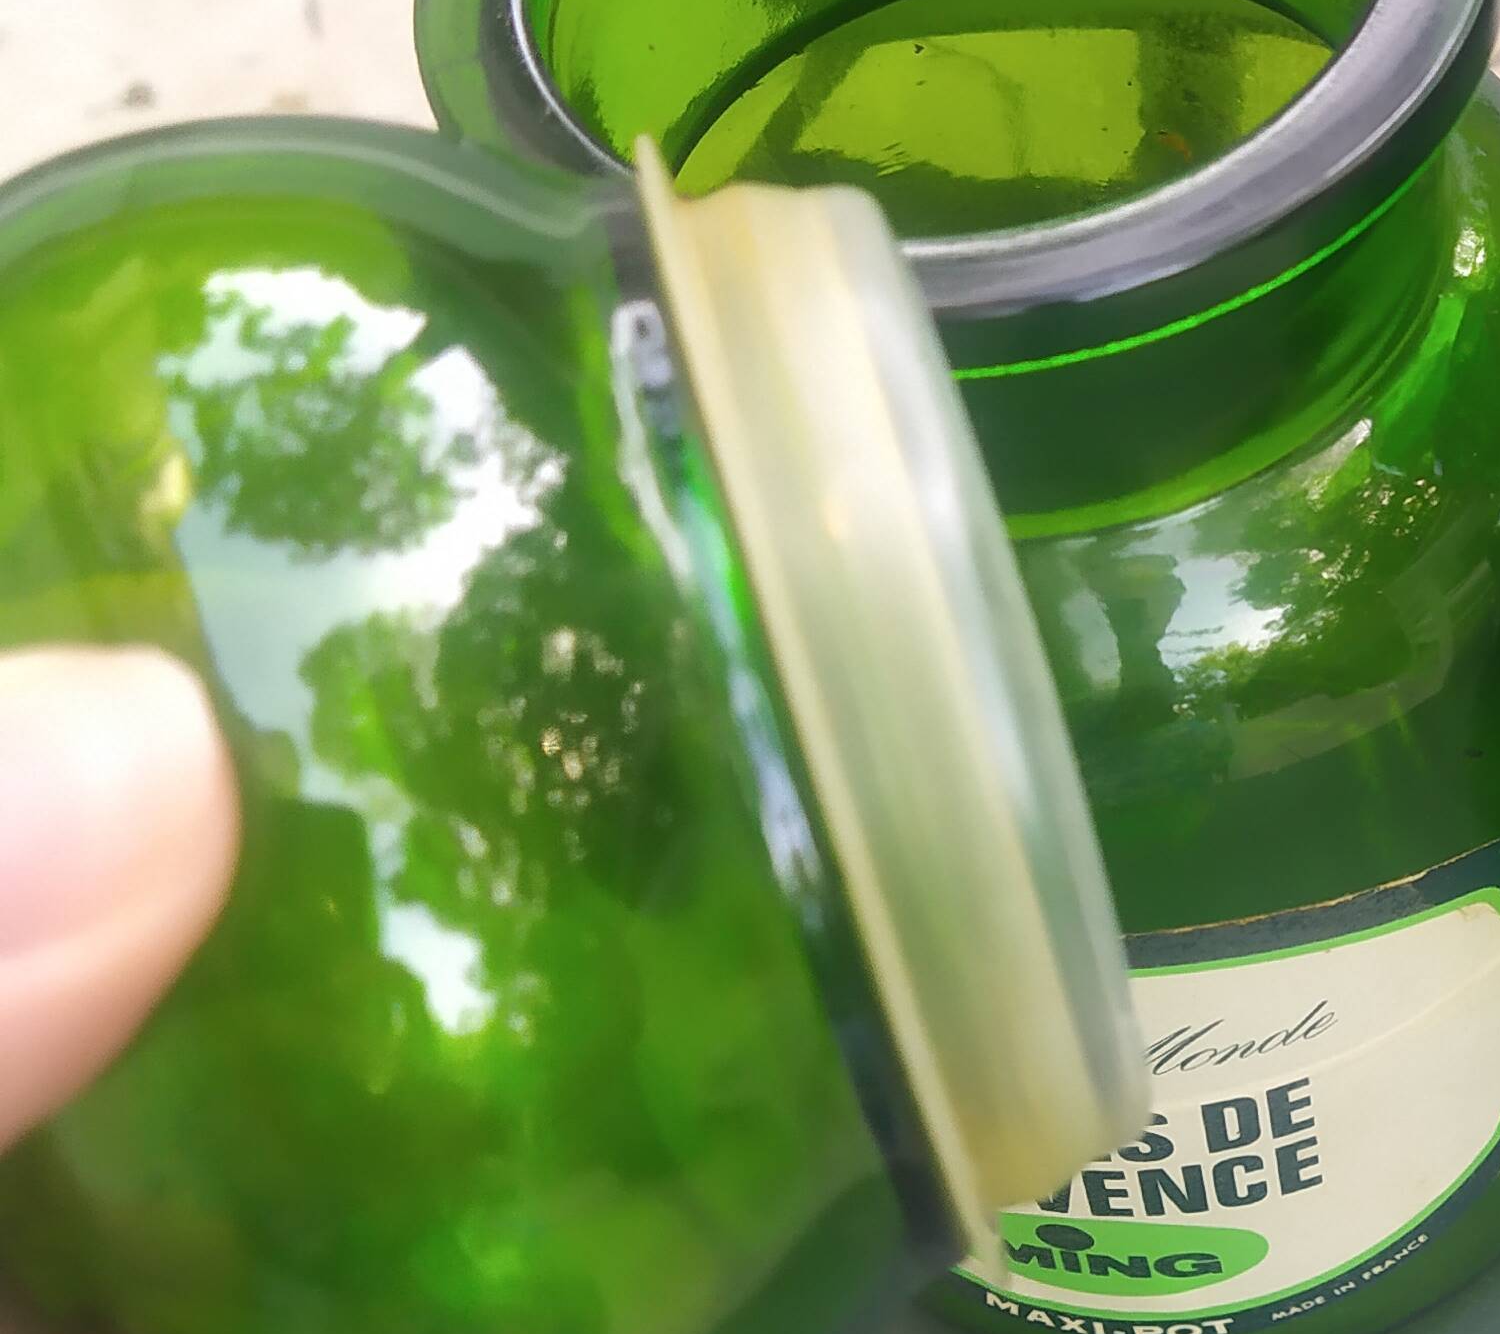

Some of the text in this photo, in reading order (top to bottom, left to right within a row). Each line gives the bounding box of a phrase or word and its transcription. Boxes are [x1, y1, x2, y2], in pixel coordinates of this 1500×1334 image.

[1201, 1077, 1315, 1153] DE
[1271, 1234, 1429, 1321] MADE IN FRANCE
